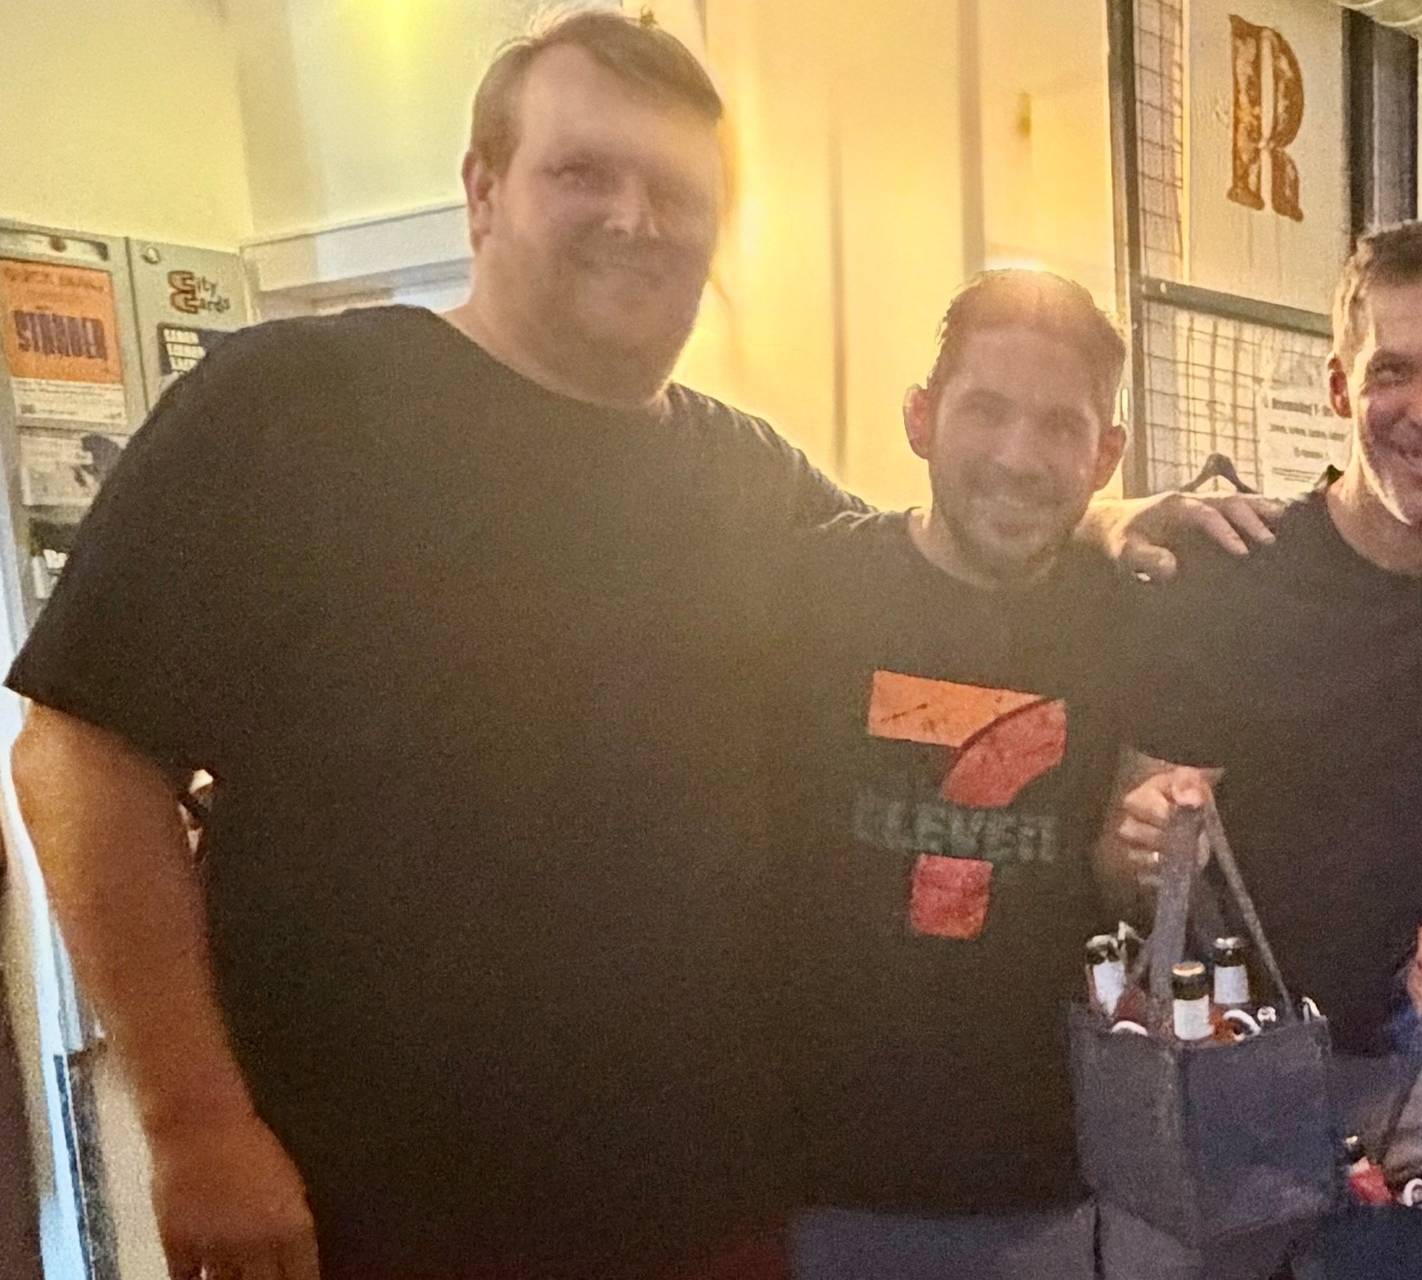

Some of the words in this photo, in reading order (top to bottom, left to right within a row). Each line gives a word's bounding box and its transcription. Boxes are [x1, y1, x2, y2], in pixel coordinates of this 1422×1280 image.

[1227, 13, 1304, 222] R
[167, 269, 218, 298] City
[169, 290, 232, 315] Cards
